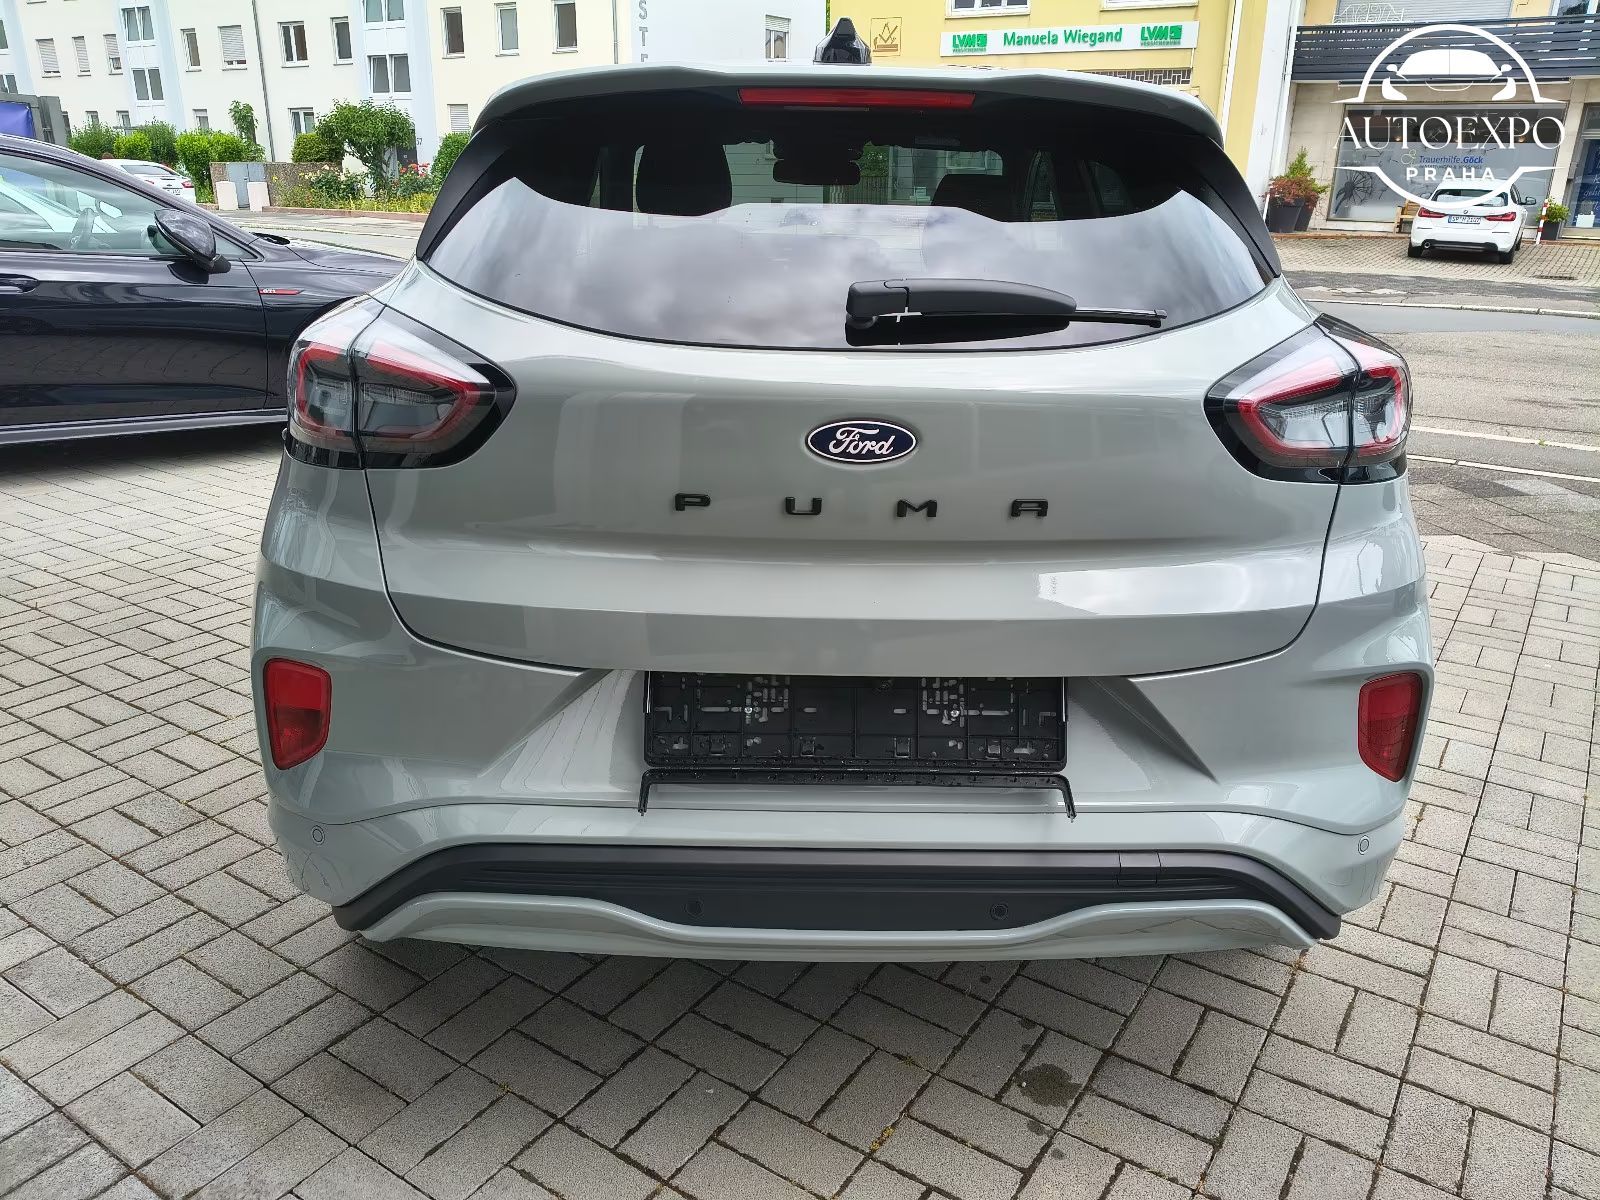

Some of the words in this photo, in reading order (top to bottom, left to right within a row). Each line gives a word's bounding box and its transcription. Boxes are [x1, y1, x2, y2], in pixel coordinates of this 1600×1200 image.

[952, 34, 976, 48] LVM
[1003, 31, 1059, 46] Manuela
[1063, 27, 1123, 47] Wiegand
[1140, 26, 1169, 41] LVM
[828, 427, 896, 455] Ford
[674, 492, 1049, 518] PUMA
